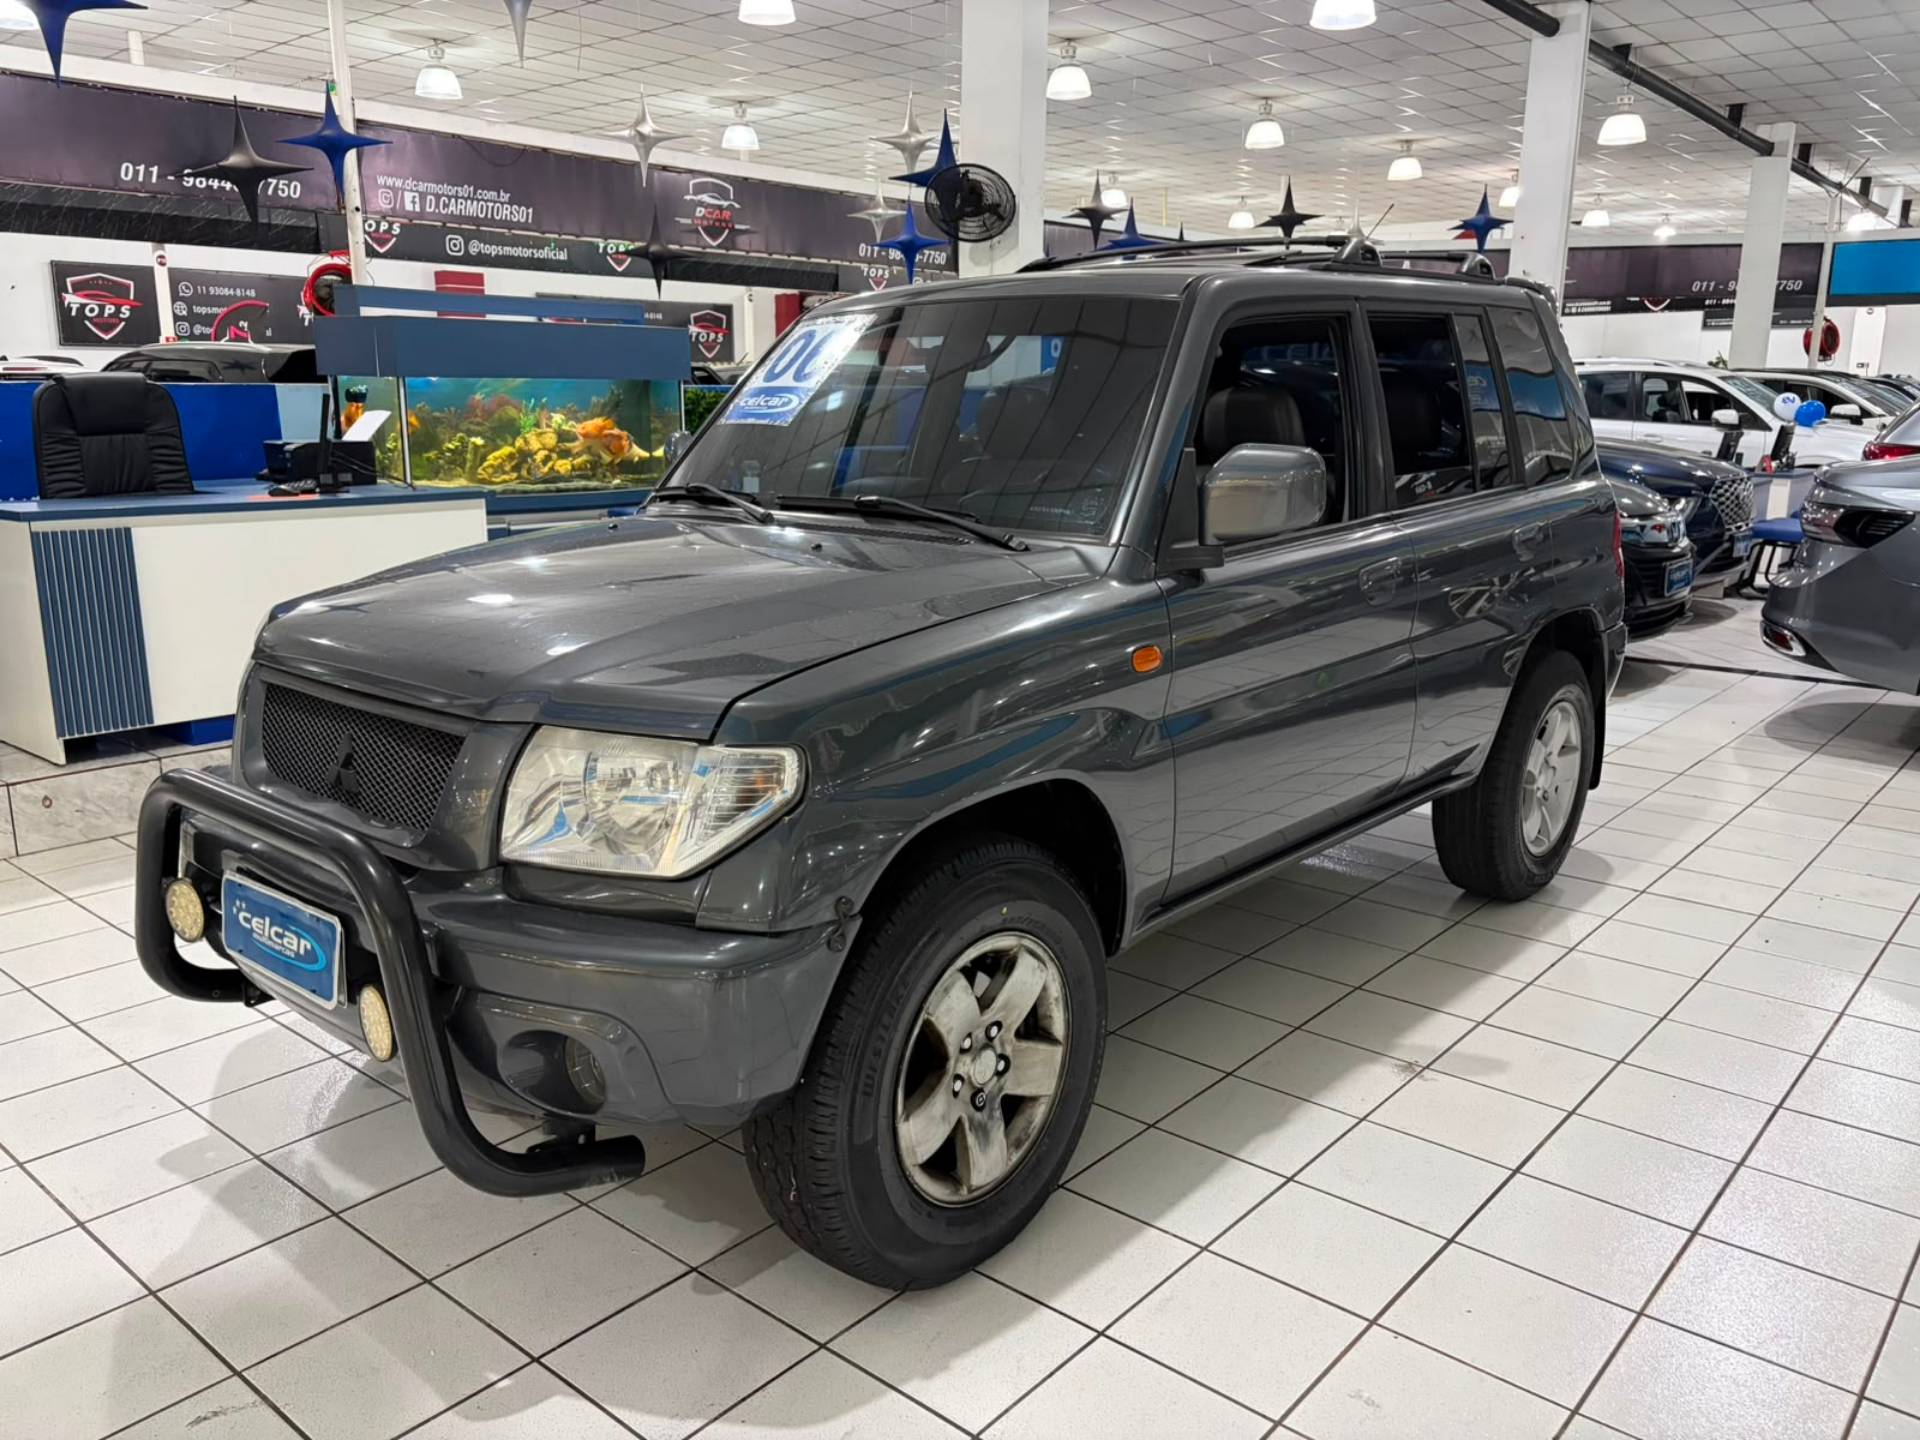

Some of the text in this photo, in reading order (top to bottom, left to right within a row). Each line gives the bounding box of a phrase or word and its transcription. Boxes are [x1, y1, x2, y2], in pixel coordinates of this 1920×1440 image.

[120, 162, 158, 183] 011
[377, 174, 511, 203] www.dcarmotors01.com.br
[426, 195, 534, 223] D.CARMOTORS01
[695, 206, 732, 220] DCAR
[468, 240, 568, 260] @topsmotorsoficial
[863, 267, 890, 279] TOPS
[1692, 281, 1716, 292] 011
[69, 303, 132, 318] TOPS
[691, 332, 724, 343] TOPS
[238, 911, 312, 956] celcar
